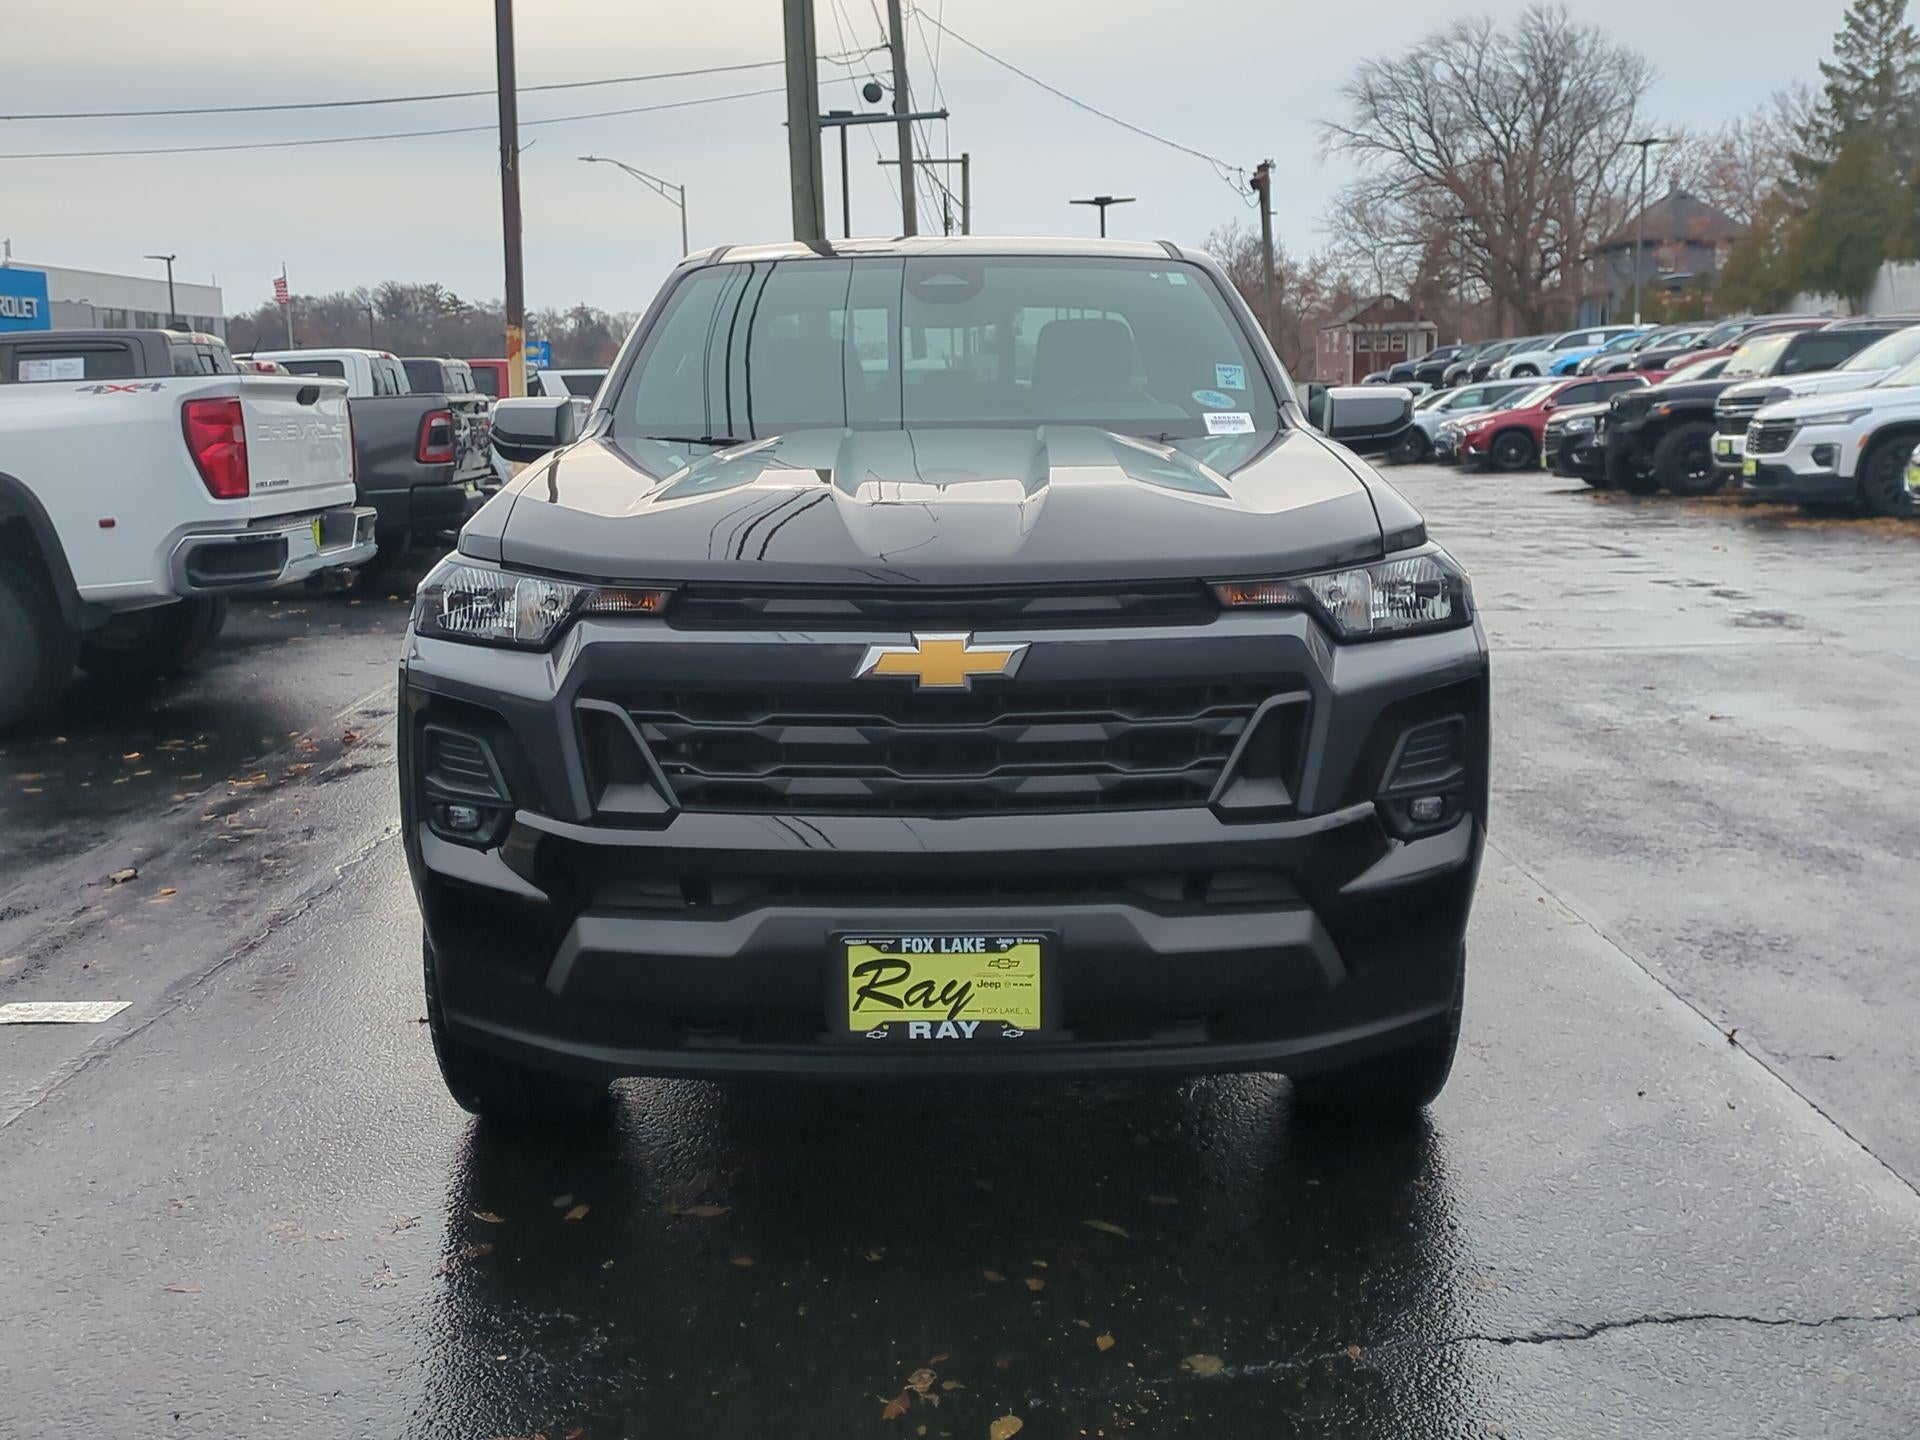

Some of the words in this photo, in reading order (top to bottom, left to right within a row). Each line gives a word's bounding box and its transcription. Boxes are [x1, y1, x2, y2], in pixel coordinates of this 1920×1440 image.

[901, 938, 933, 953] FOX
[941, 938, 986, 953] LAKE
[852, 958, 976, 1020] Ray
[976, 980, 1001, 990] Jeep
[981, 1007, 998, 1015] FOX
[908, 1021, 981, 1039] RAY
